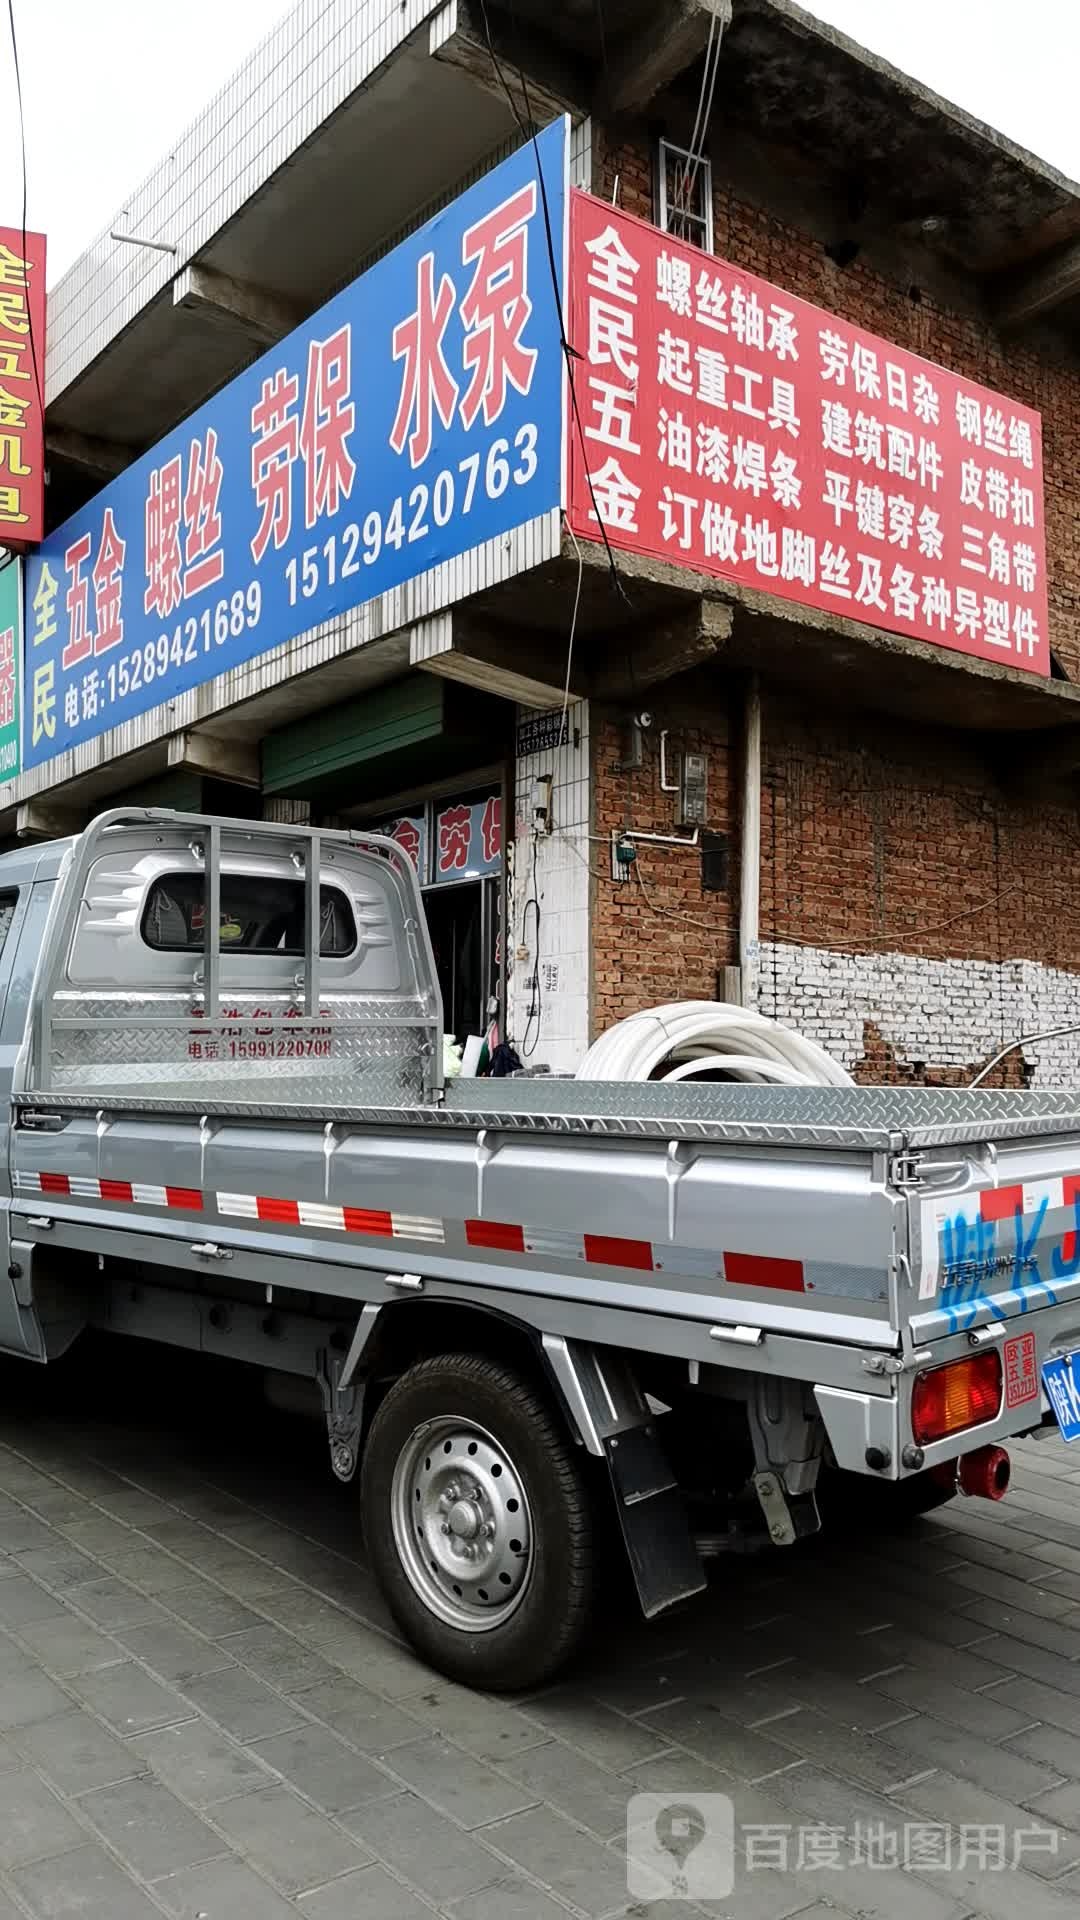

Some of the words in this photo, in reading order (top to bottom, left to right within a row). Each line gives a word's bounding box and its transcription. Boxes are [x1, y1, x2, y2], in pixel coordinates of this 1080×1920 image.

[62, 508, 126, 670] 五金
[144, 427, 224, 619] 螺丝
[251, 322, 357, 565] 劳保
[388, 180, 537, 470] 水泵
[583, 224, 641, 533] 全民五金
[655, 249, 799, 362] 螺丝轴承
[818, 328, 941, 427] 劳保日杂
[955, 390, 1034, 471] 钢丝绳
[656, 327, 801, 440] 起重工具
[820, 398, 945, 493] 建筑配件
[961, 457, 1036, 528] 皮带扣
[63, 580, 262, 730] 电话:15289421689
[284, 422, 539, 607] 15129420763
[657, 407, 802, 512] 油漆焊条
[822, 468, 945, 561] 平键穿条
[960, 523, 1037, 594] 三角带
[657, 485, 1041, 657] 订做地脚丝及各种异型件
[32, 561, 59, 748] 全民
